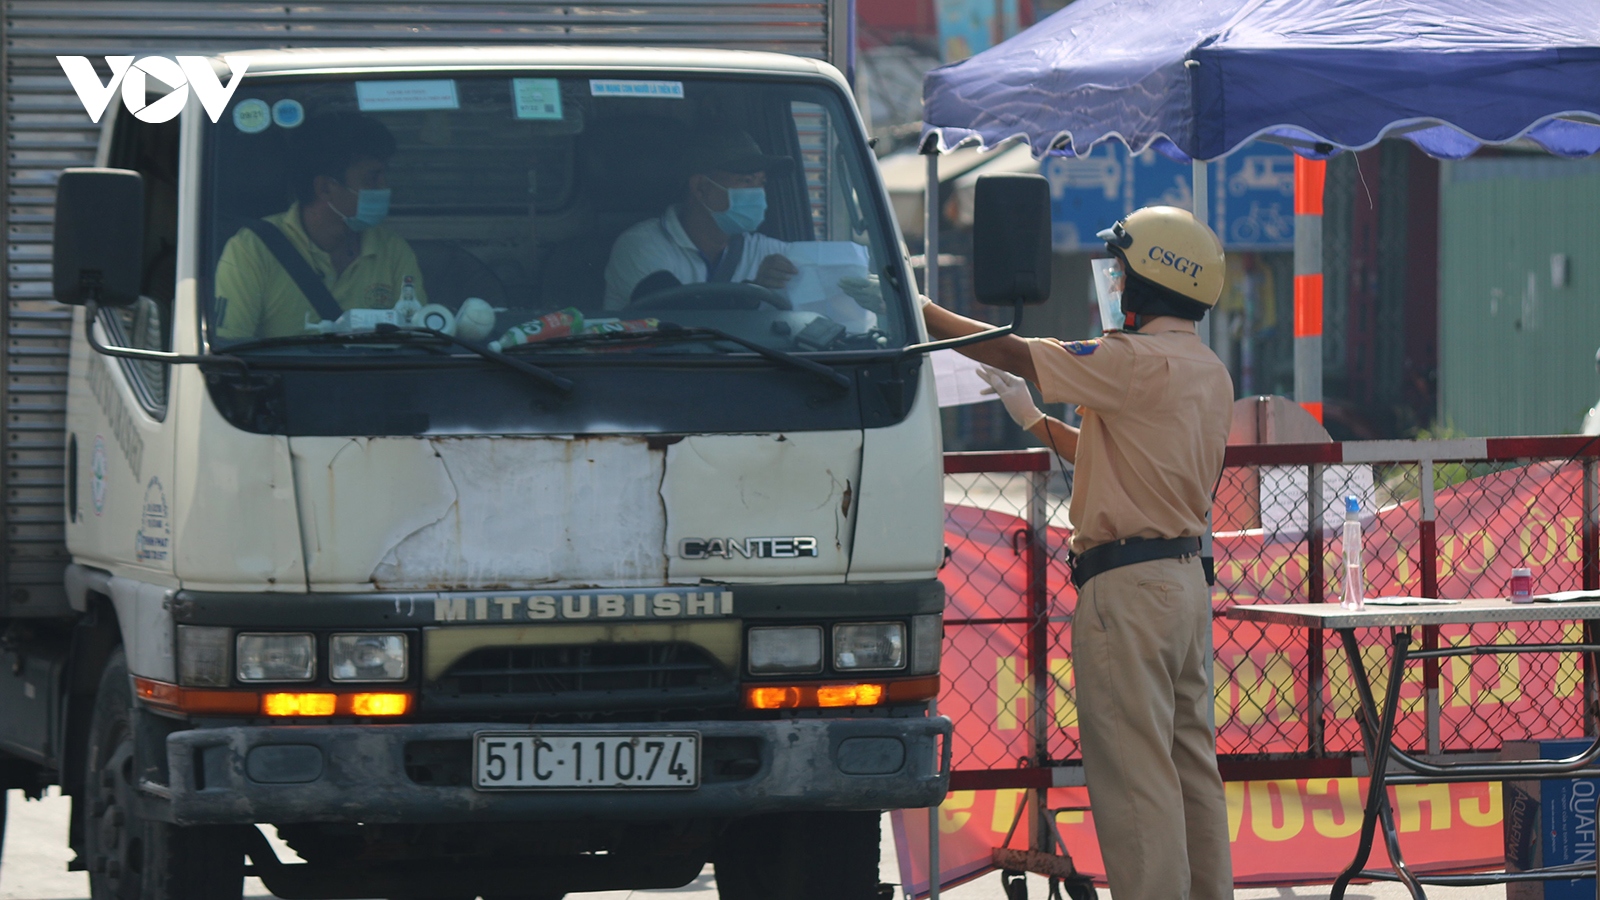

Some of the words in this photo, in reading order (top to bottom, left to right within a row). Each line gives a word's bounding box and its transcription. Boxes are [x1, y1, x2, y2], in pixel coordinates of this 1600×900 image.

[1148, 245, 1203, 279] CSGT
[679, 536, 818, 559] CANTER
[433, 591, 734, 621] MITSUBISHI
[1507, 787, 1529, 861] AQUAFINA
[1569, 778, 1596, 883] QUAFIN
